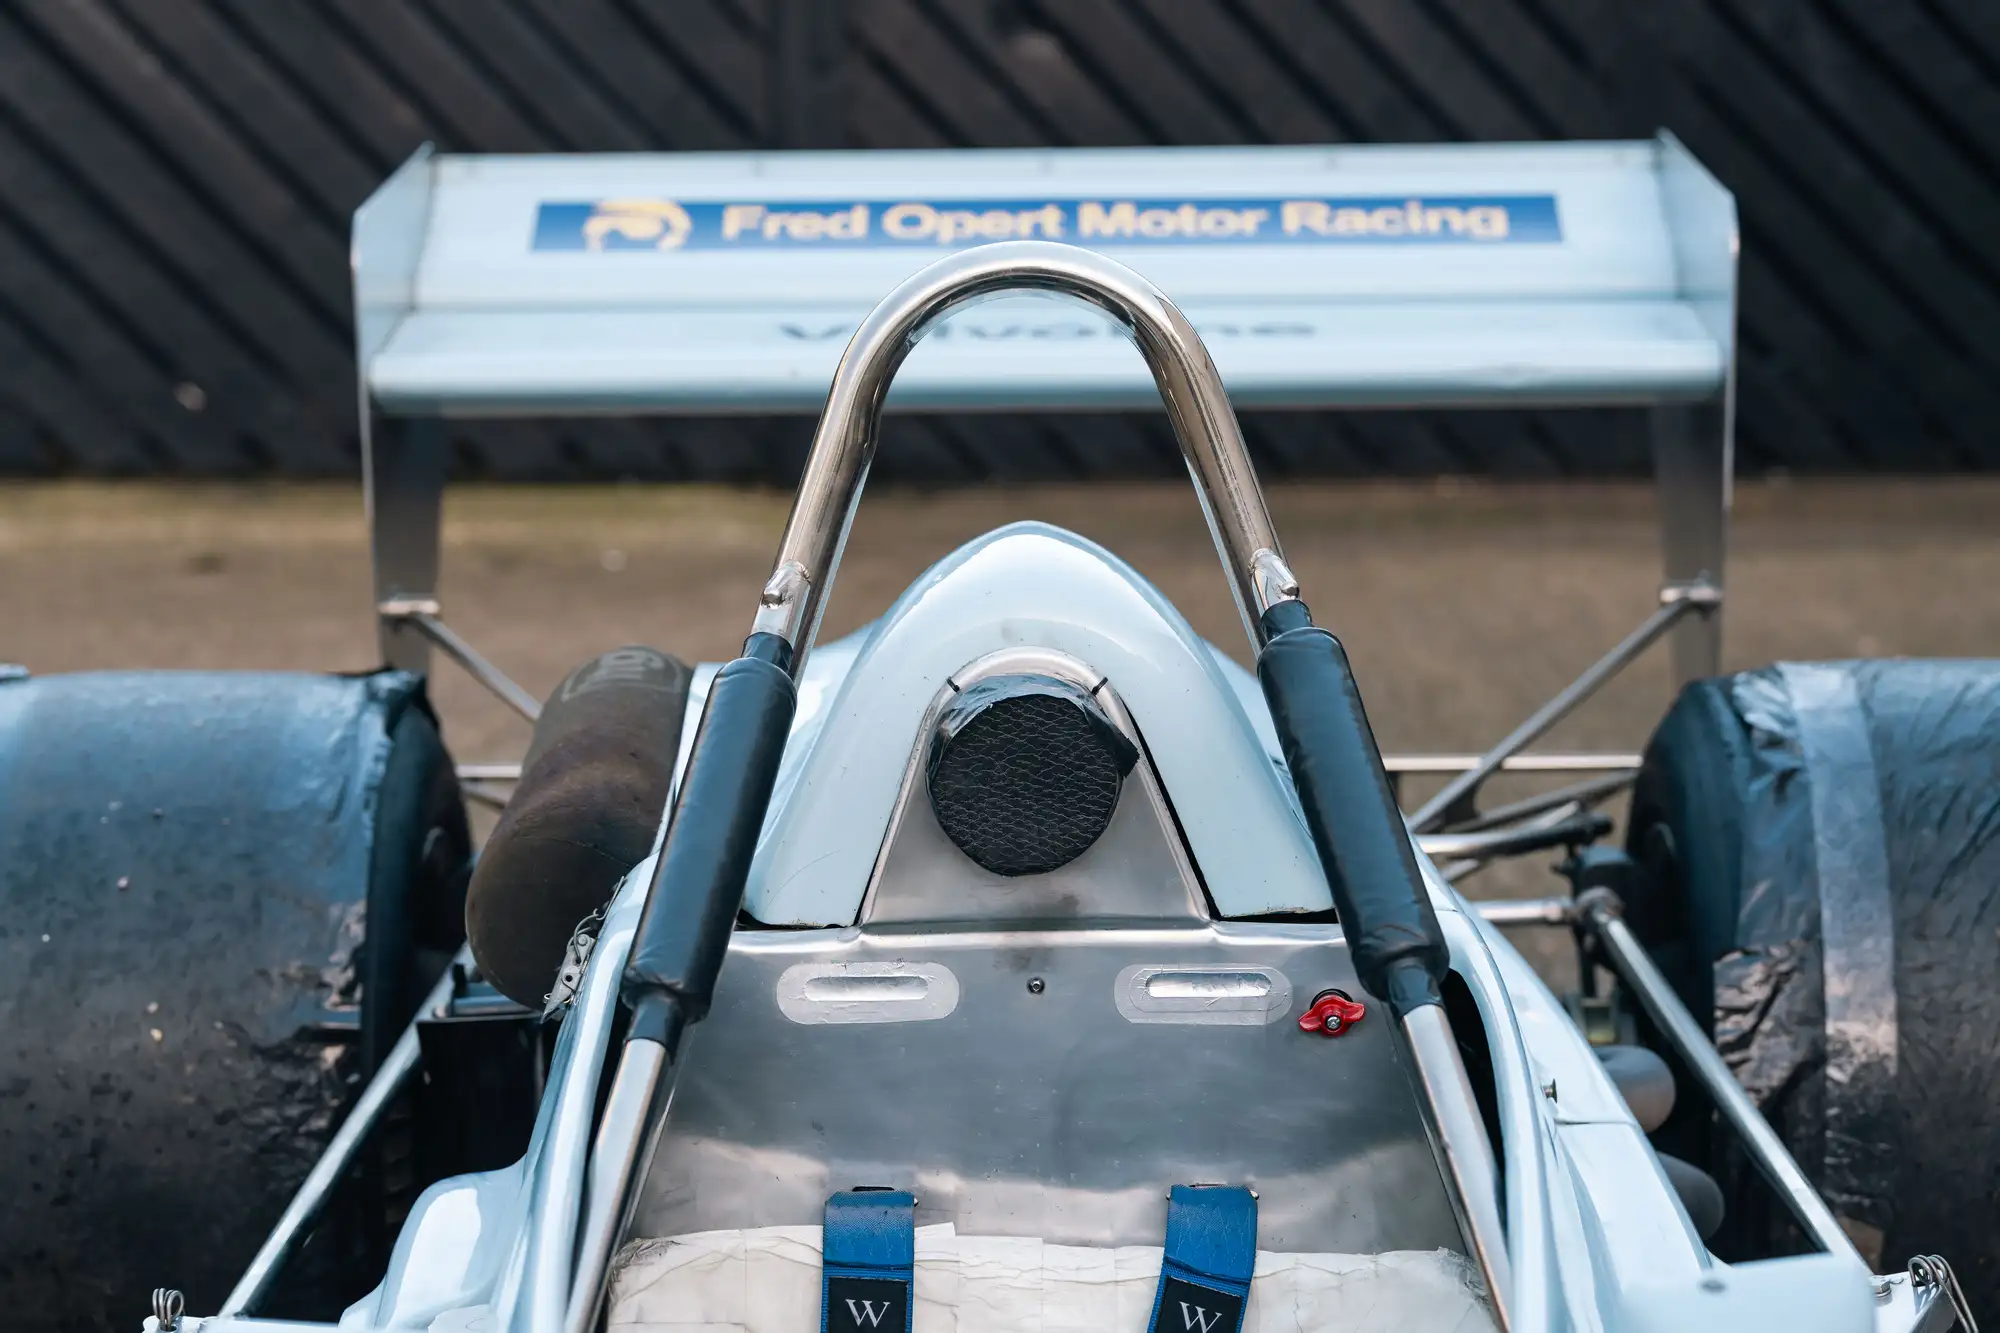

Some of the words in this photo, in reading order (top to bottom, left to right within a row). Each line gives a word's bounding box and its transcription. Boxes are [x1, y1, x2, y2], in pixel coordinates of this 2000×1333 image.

[722, 203, 869, 241] Fred
[881, 202, 1066, 244] Opert
[1077, 200, 1269, 238] Motor
[1281, 199, 1509, 240] Racing
[845, 1298, 891, 1328] W
[1179, 1301, 1223, 1333] W
